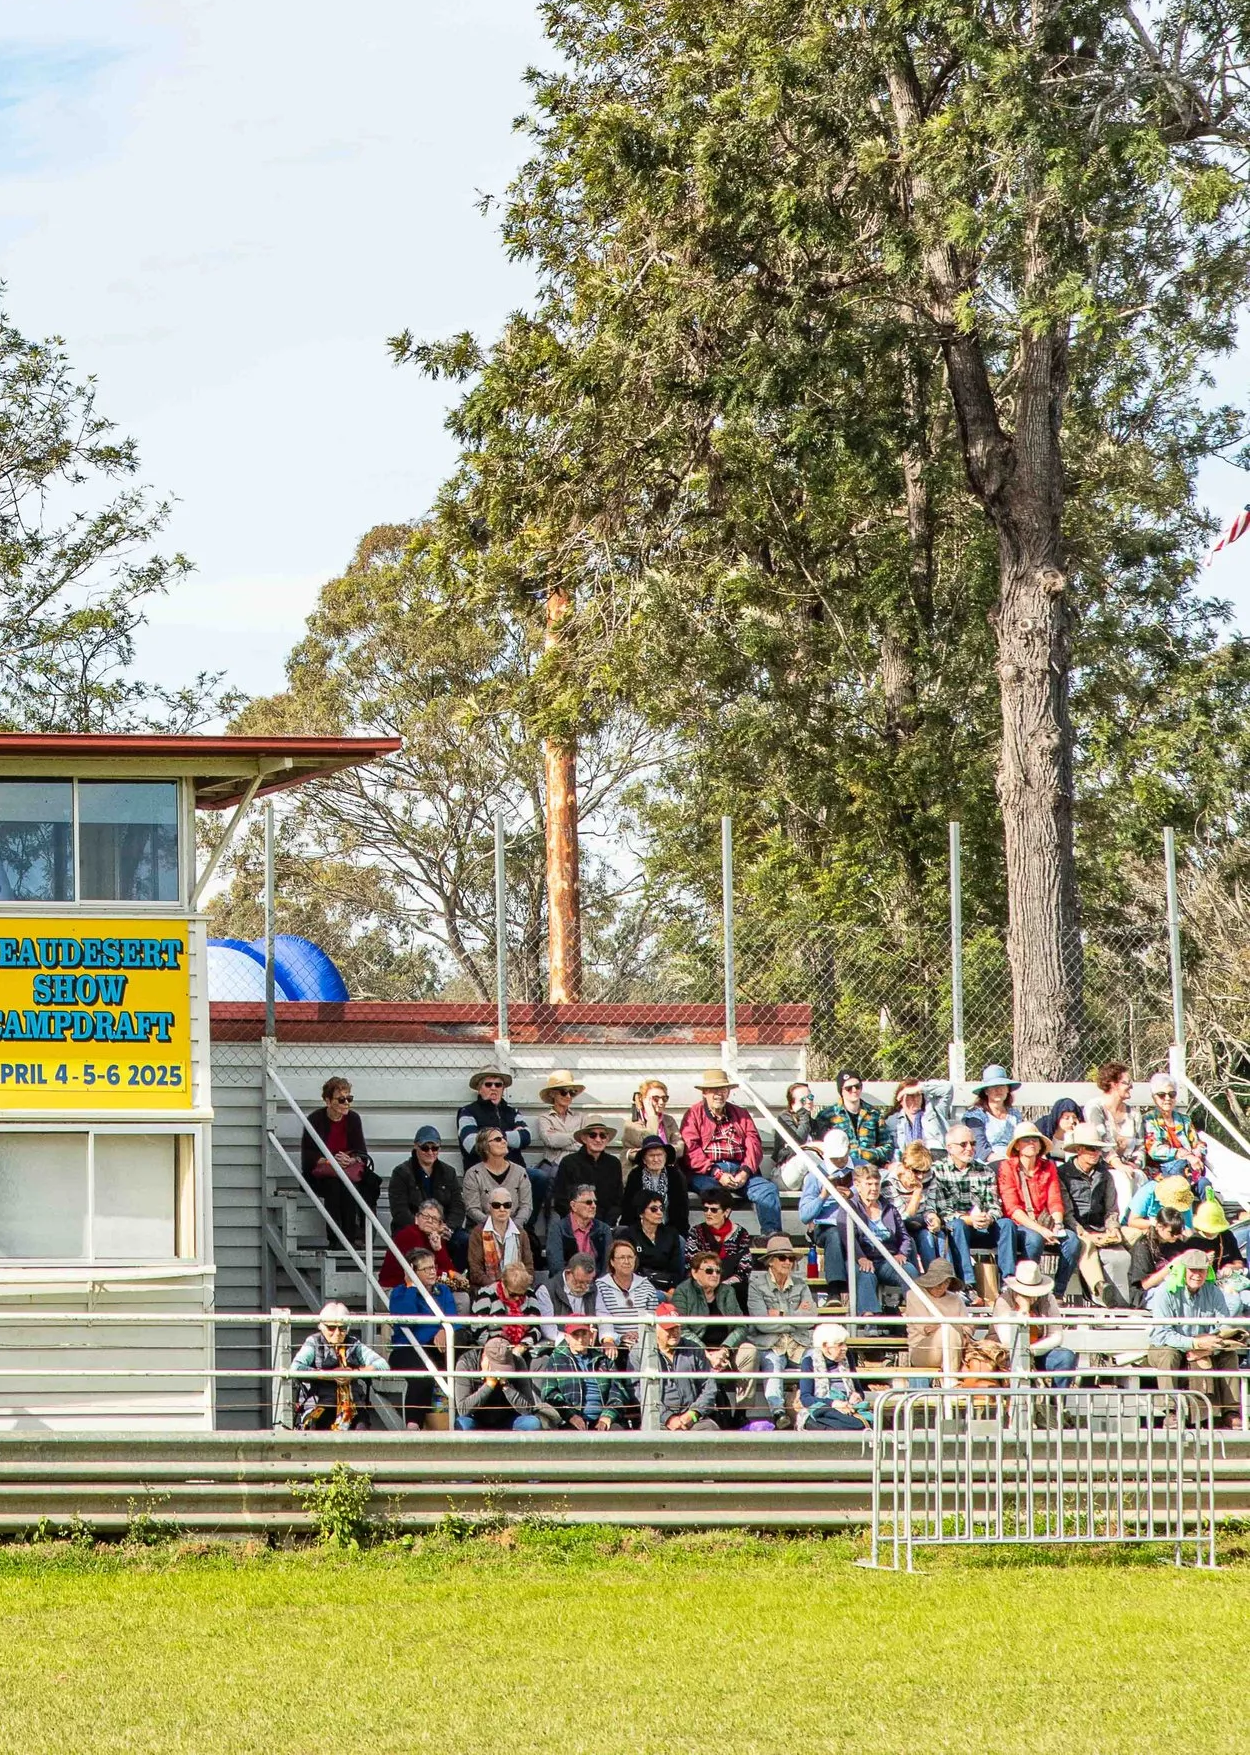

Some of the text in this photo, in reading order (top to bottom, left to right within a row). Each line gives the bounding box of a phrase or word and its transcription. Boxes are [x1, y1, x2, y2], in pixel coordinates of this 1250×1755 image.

[32, 974, 128, 1006] SHOW
[54, 1064, 68, 1084] 4
[127, 1064, 183, 1085] 2025
